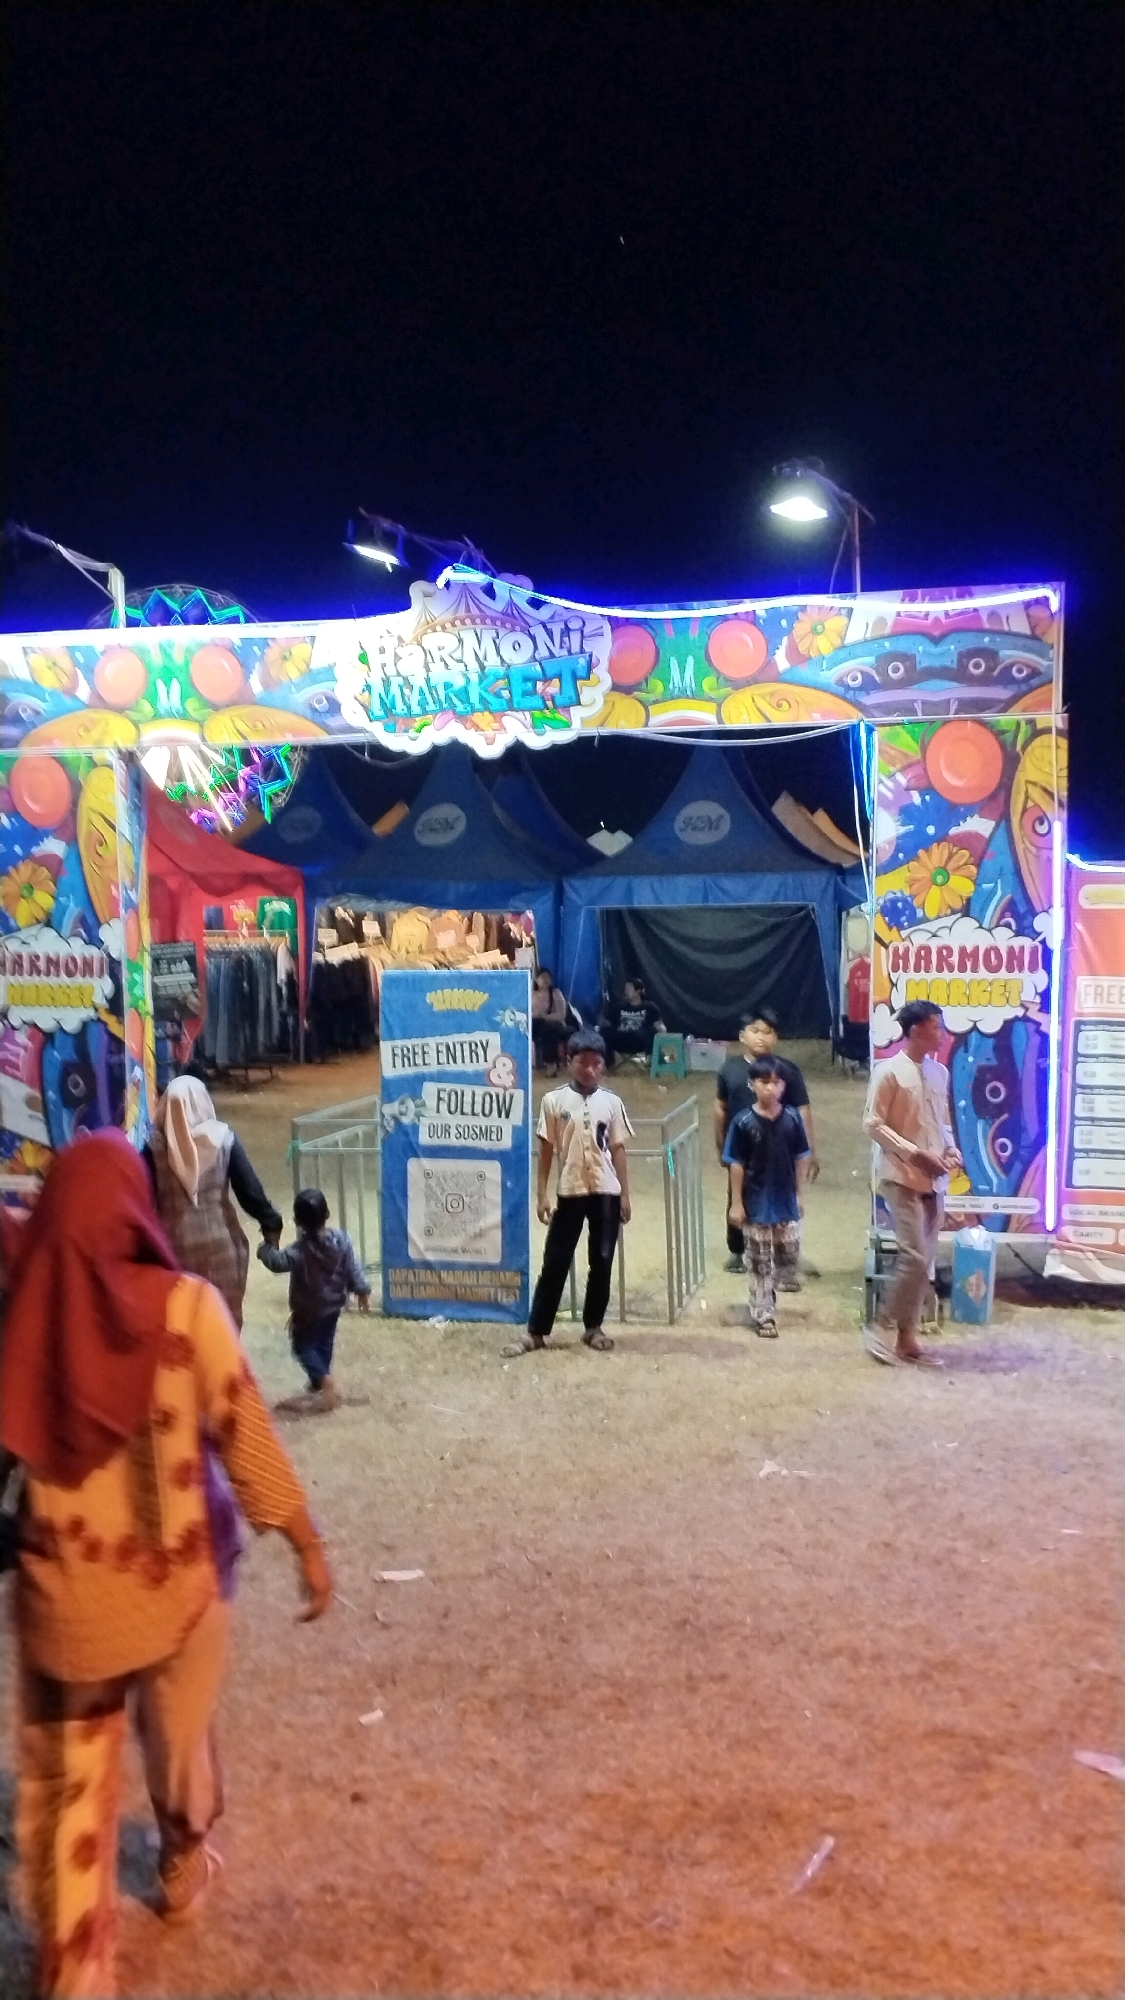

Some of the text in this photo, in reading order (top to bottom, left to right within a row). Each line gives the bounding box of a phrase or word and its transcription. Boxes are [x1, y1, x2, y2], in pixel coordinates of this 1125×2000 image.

[366, 652, 593, 721] MARKET
[890, 943, 1042, 975] HARMONI
[906, 977, 1023, 1008] MARKET
[1084, 984, 1125, 1005] FREE
[390, 1038, 490, 1069] FREE ENTRY
[489, 1056, 515, 1089] &
[435, 1086, 515, 1120] FOLLOW
[427, 1121, 504, 1142] OUR SOSMED
